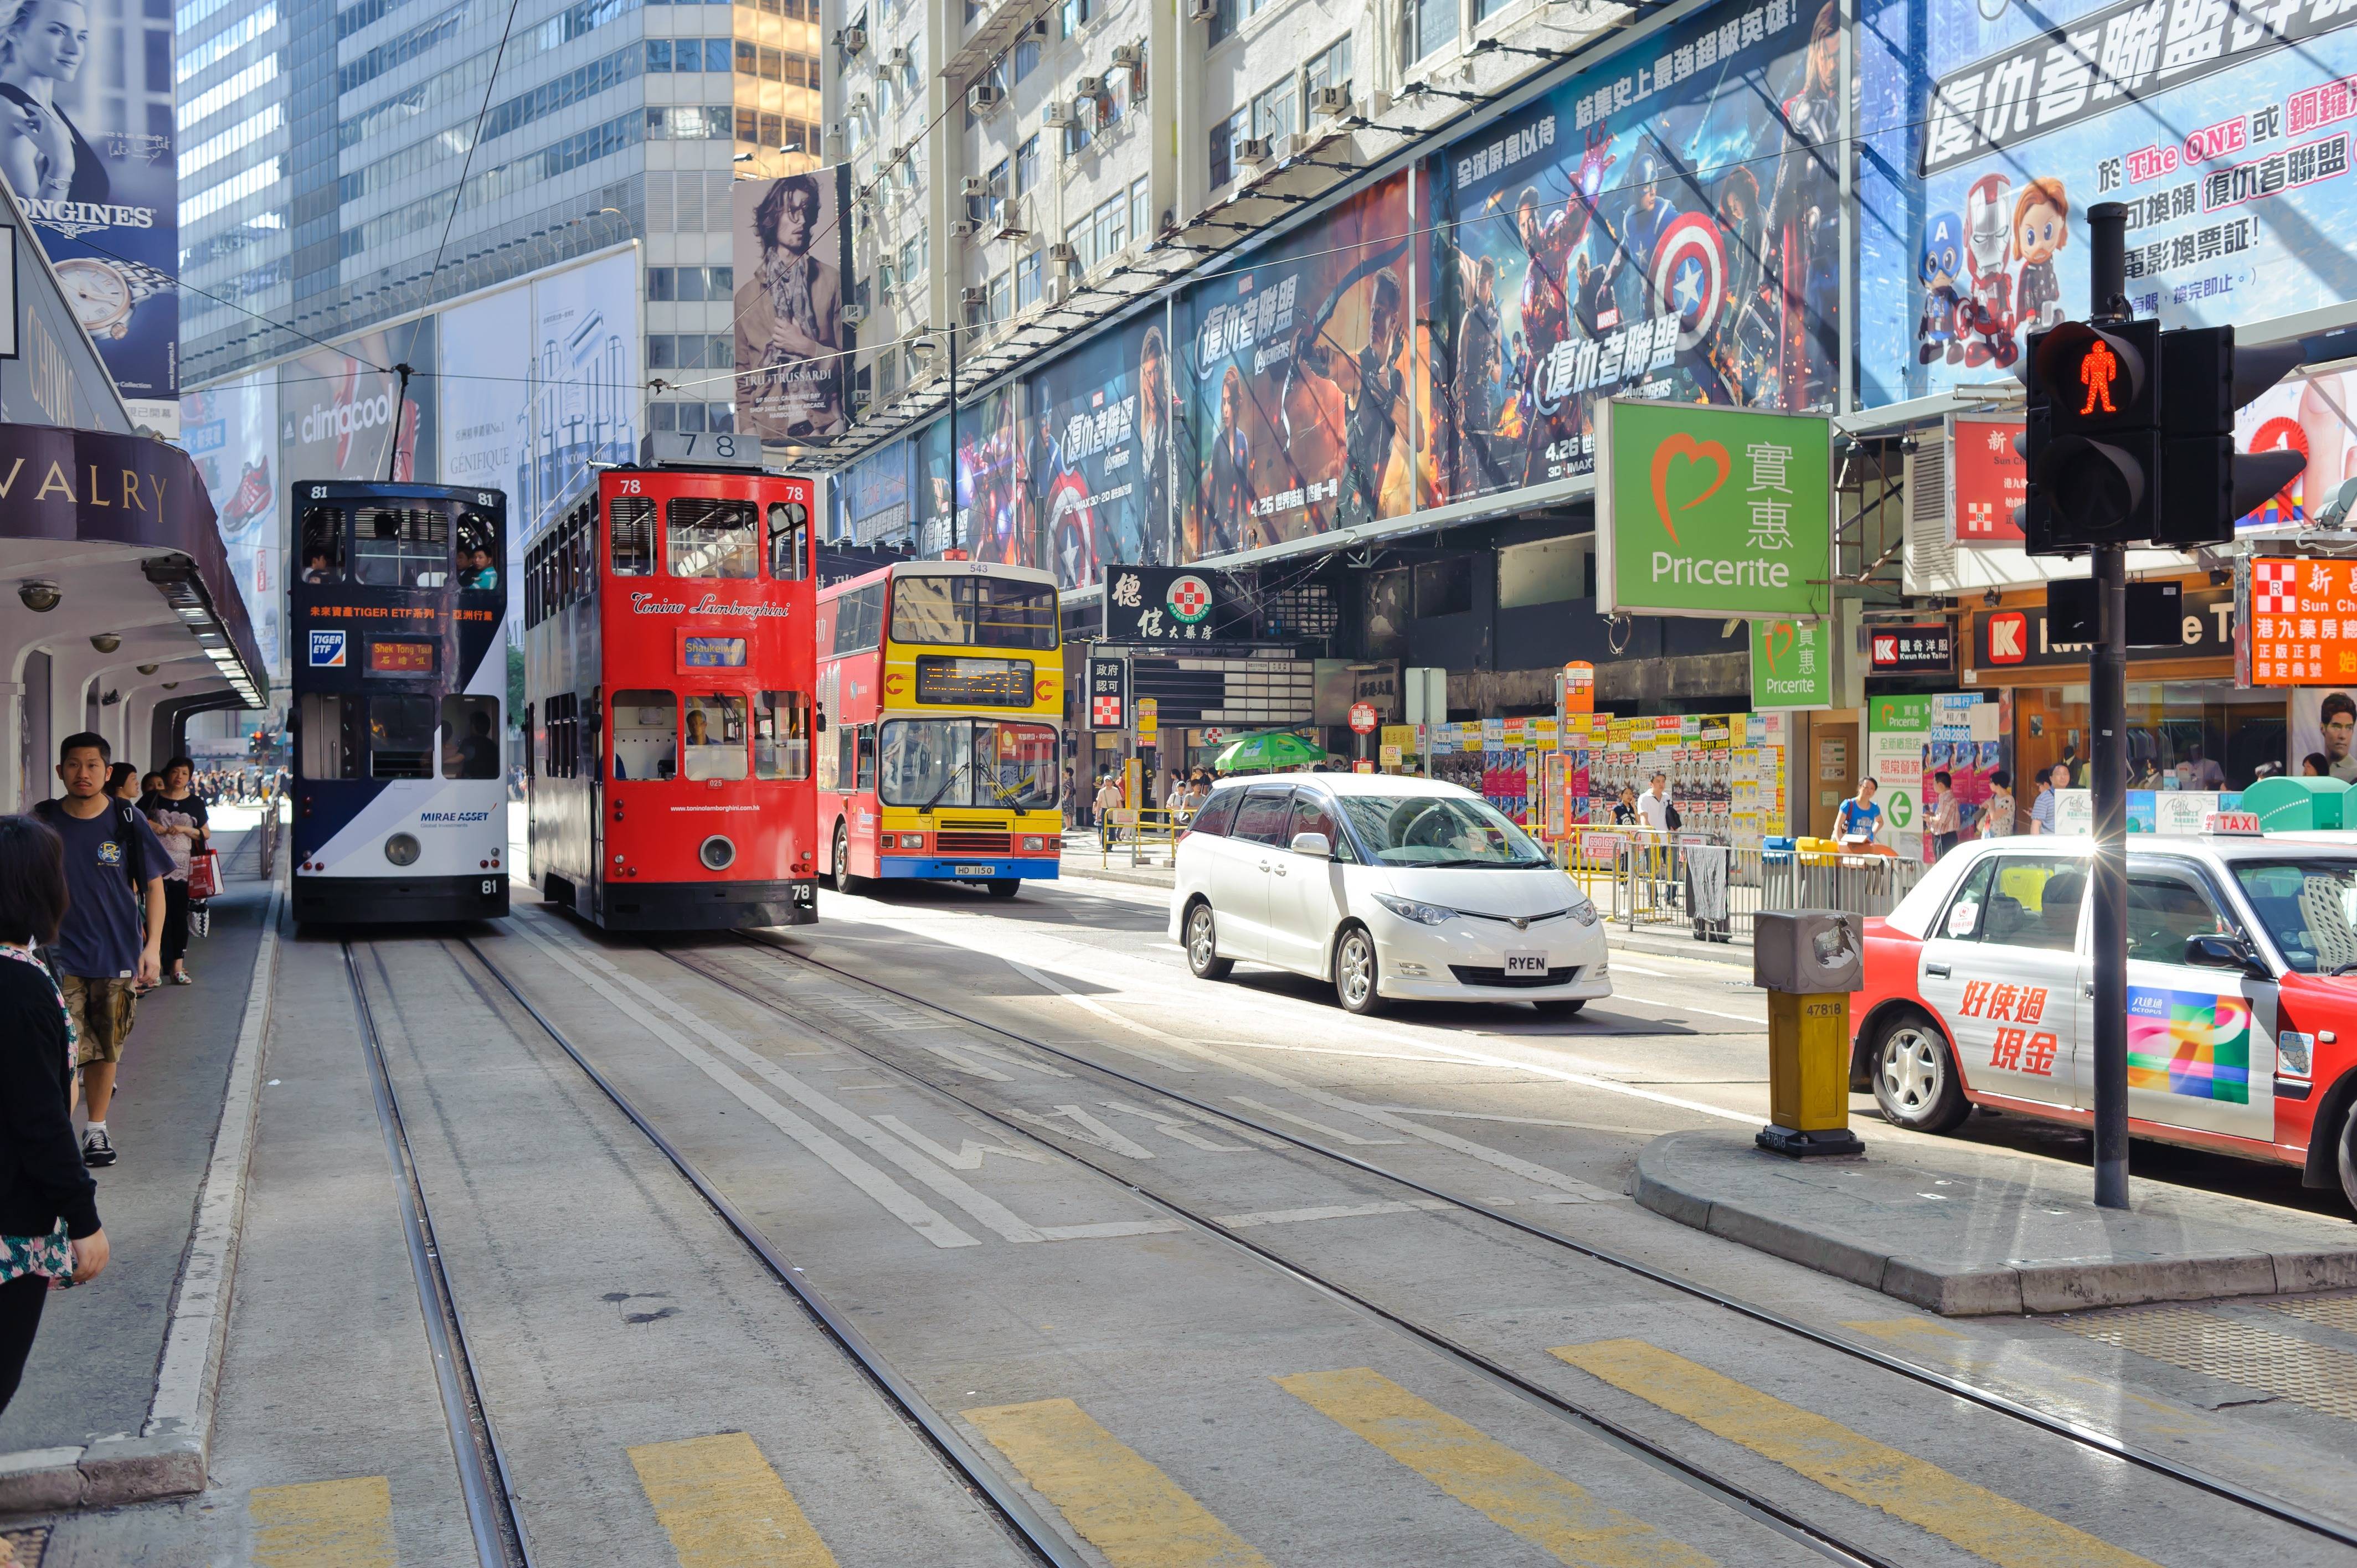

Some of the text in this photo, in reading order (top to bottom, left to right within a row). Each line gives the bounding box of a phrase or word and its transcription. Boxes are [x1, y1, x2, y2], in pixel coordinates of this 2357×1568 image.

[2098, 80, 2357, 192] 於 The ONE 或 銅鑼
[1456, 115, 1556, 190] 全球屏息以待
[2124, 136, 2347, 231] 可換領 復仇者聯盟
[1202, 274, 1299, 367] 復仇者聯盟
[1597, 309, 1618, 330] MARVEL
[1545, 310, 1682, 402] 復仇者聯盟
[302, 383, 394, 444] climacool
[1067, 395, 1135, 465] 復仇者聯盟
[1545, 432, 1595, 462] 4.26 世
[450, 446, 510, 475] GÉNIFIQUE
[1548, 457, 1593, 478] 3D IMAX
[1994, 456, 2010, 465] Sun
[311, 486, 328, 499] 81
[620, 479, 641, 494] 78
[786, 486, 804, 501] 78
[477, 492, 494, 507] 81
[1745, 441, 1794, 550] 實惠
[1250, 496, 1274, 517] 4.26
[969, 564, 988, 574] 543
[1652, 551, 1789, 588] Pricerite
[630, 592, 790, 621] Tonino Lamborghini
[2301, 599, 2329, 612] Sun
[313, 635, 342, 644] TIGER
[313, 644, 332, 654] ETF
[374, 644, 393, 654] Shek
[396, 644, 414, 656] Tong
[2258, 643, 2322, 659] 正版正貨
[1095, 664, 1119, 676] 政府
[2258, 662, 2322, 678] 指定商號
[1095, 679, 1118, 692] 認可
[1766, 678, 1815, 694] Pricerite
[1889, 718, 1919, 727] Pricerite
[420, 811, 488, 822] MIRAE ASSET
[2220, 815, 2258, 832] TAXI
[1589, 836, 1603, 847] 690
[957, 866, 993, 875] HD 1150
[482, 879, 497, 894] 81
[791, 884, 810, 900] 78
[1509, 956, 1545, 971] RYEN
[1807, 1003, 1841, 1016] 47818
[1959, 979, 2049, 1024] 好使過
[2132, 996, 2163, 1009] 八達通
[2132, 1007, 2162, 1015] OCTOPUS
[1989, 1026, 2057, 1076] 現金
[1764, 1131, 1787, 1148] 47818
